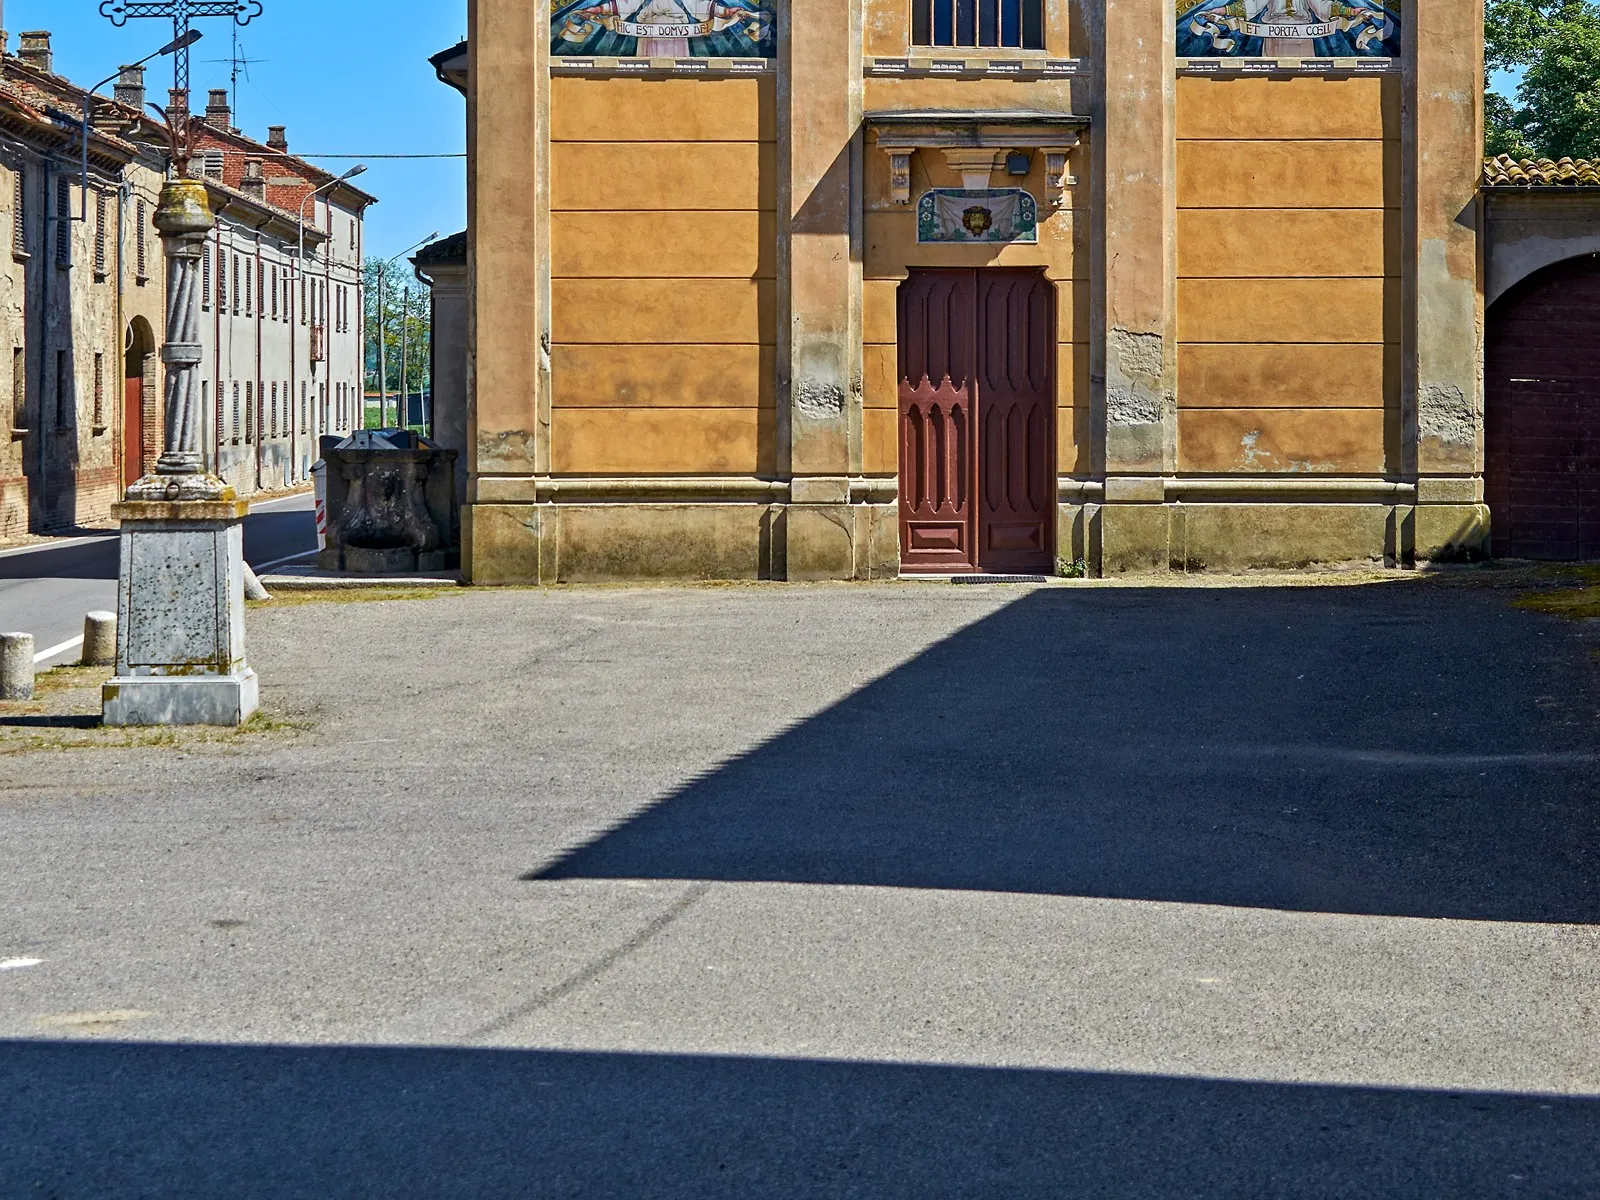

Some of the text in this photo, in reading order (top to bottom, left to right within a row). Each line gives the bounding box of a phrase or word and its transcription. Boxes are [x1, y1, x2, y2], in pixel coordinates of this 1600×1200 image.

[616, 21, 631, 34] HIC
[636, 25, 653, 36] EST
[658, 25, 689, 36] DOMVS
[1246, 24, 1260, 35] ET
[1268, 25, 1300, 37] PORTA
